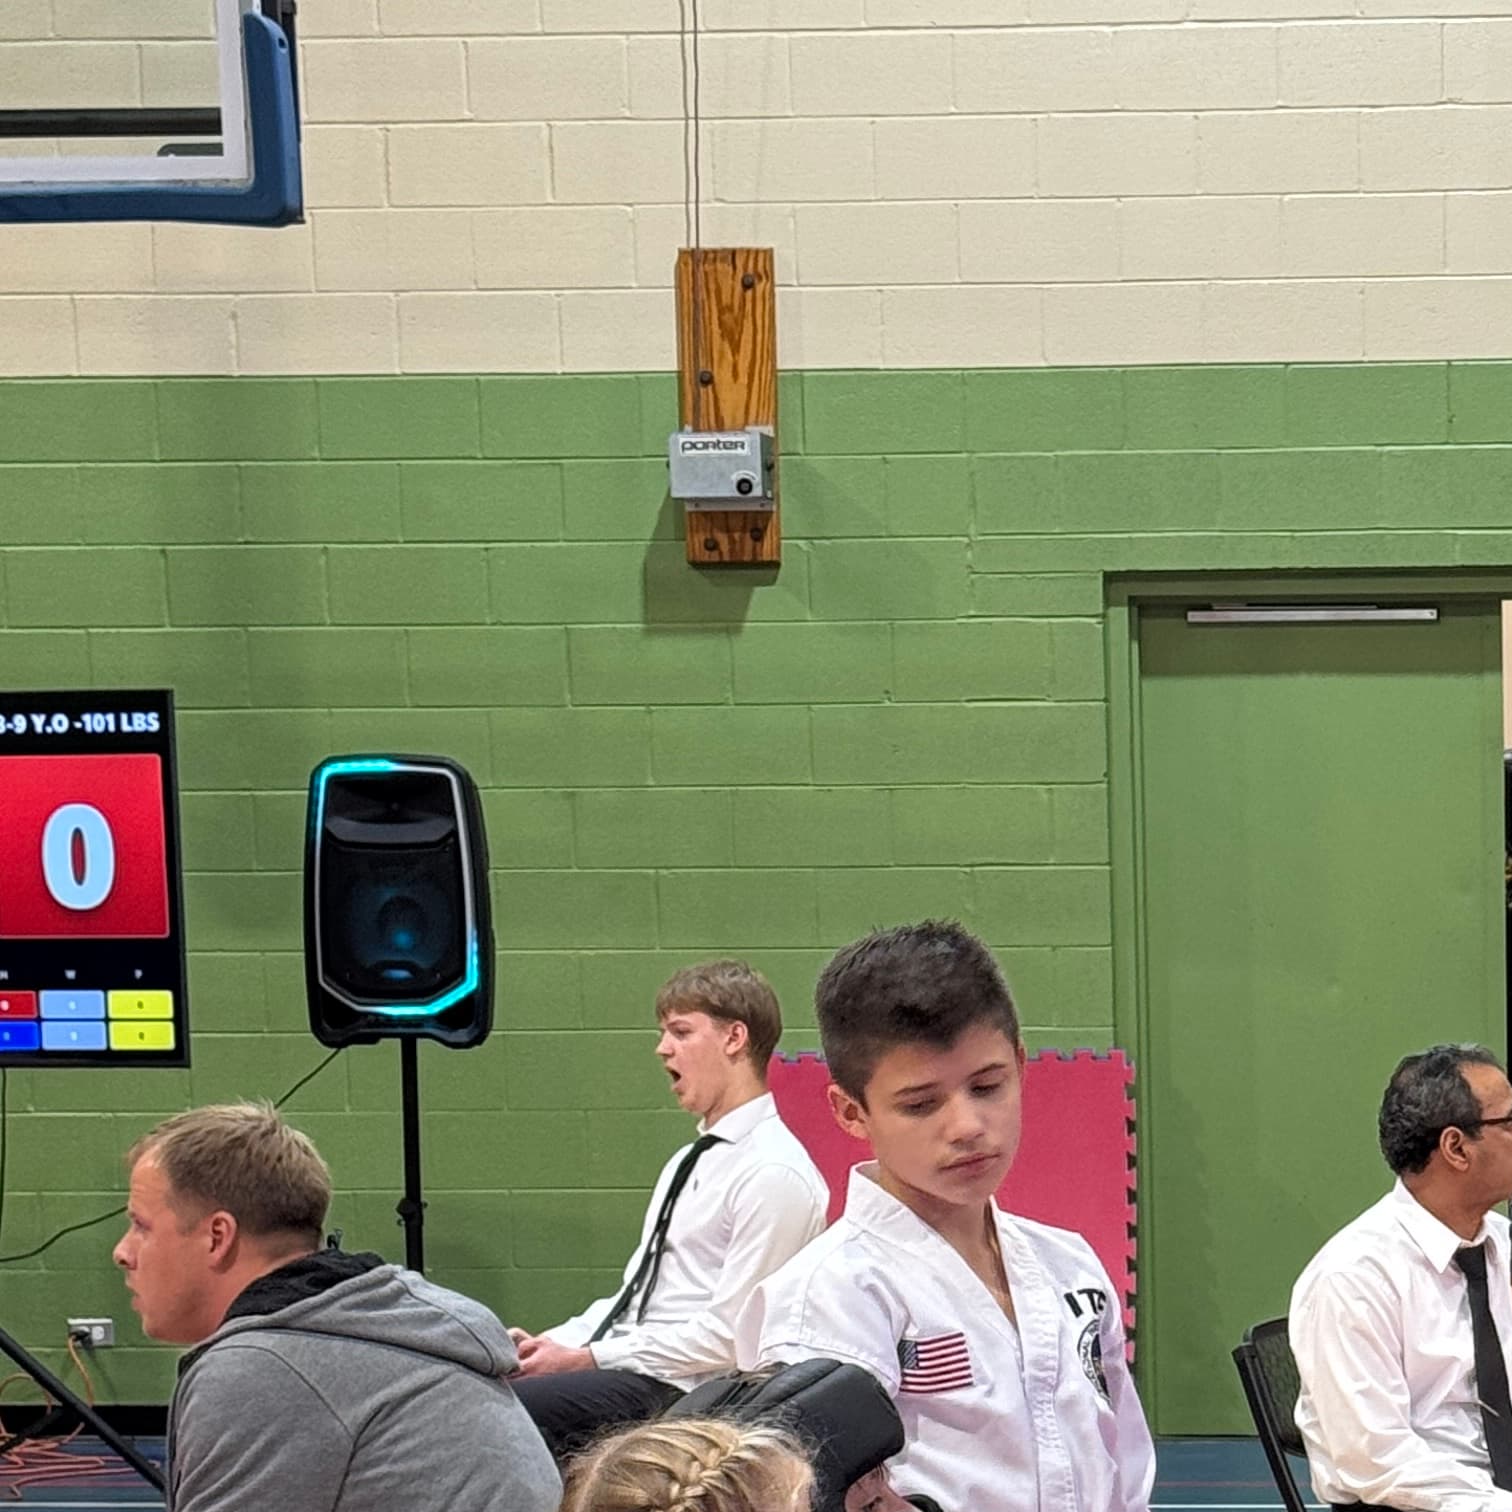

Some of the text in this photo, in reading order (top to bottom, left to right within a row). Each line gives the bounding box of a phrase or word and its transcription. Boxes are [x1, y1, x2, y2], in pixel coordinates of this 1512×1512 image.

[72, 712, 116, 733] -101
[119, 711, 160, 733] LBS
[41, 801, 116, 911] 0
